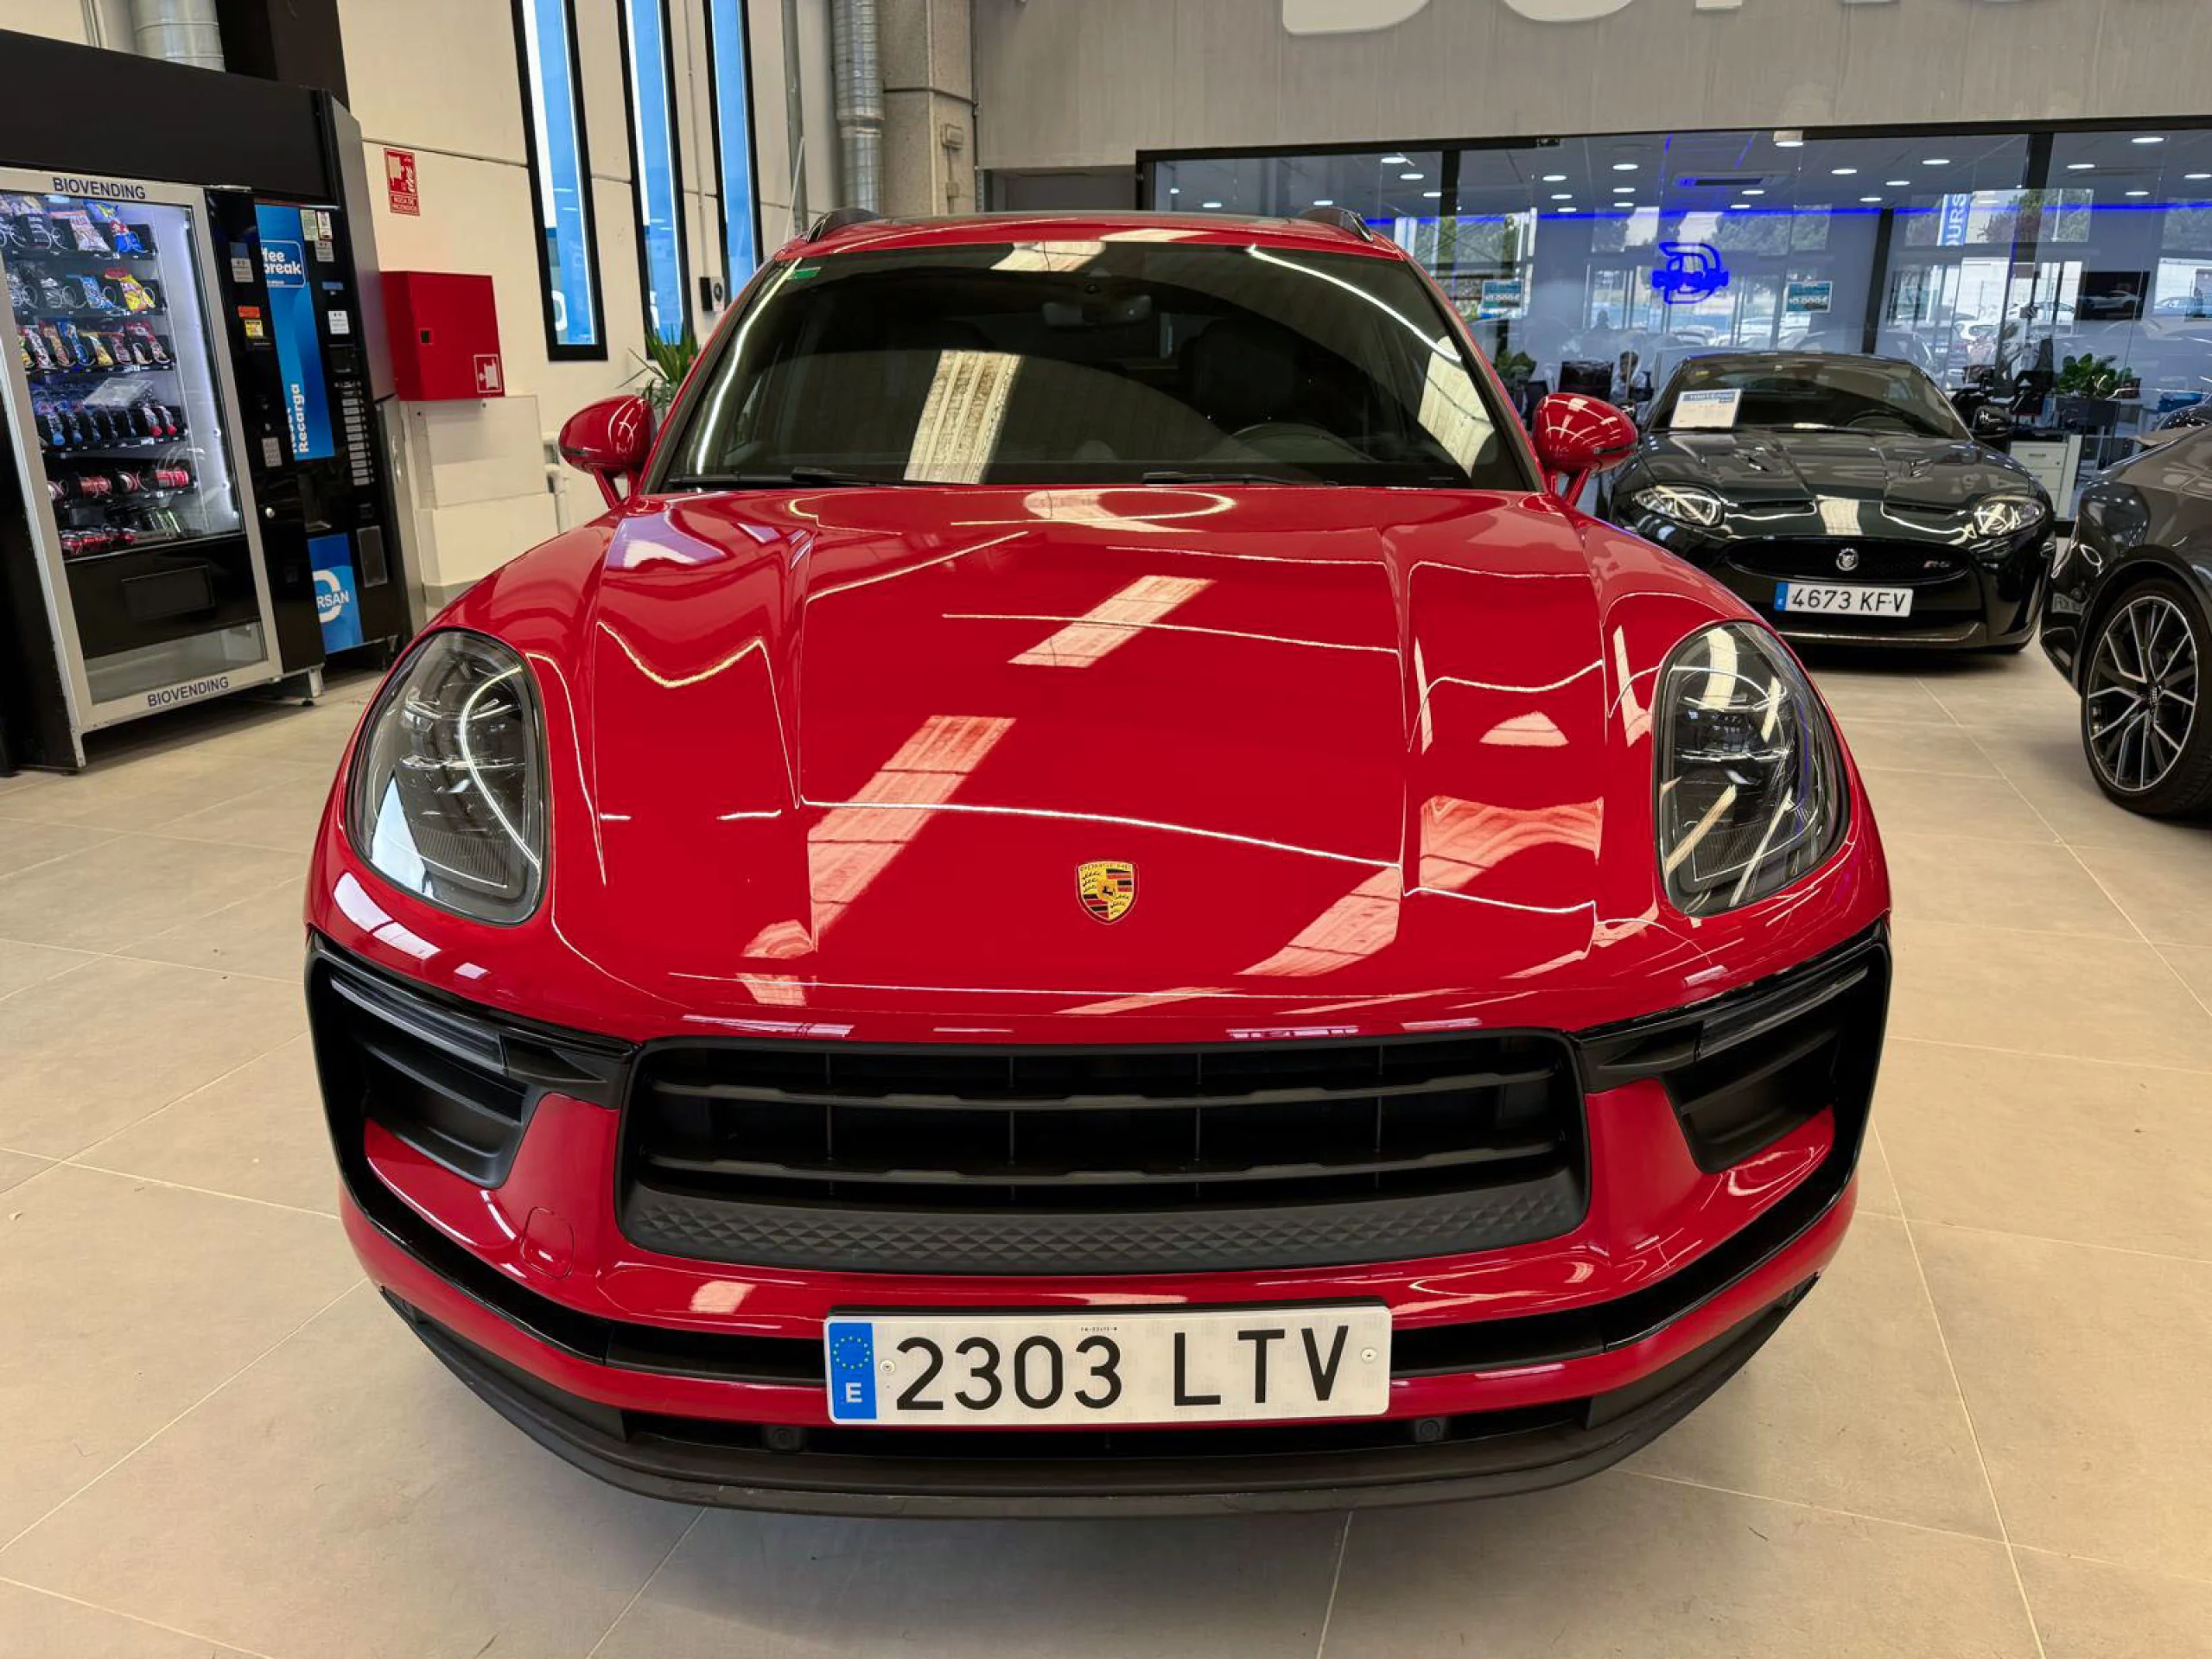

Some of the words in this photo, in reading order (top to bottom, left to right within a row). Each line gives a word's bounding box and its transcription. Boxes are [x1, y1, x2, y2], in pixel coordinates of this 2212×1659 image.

[53, 177, 146, 200] BIOVENDING
[290, 384, 309, 453] Recarga
[1792, 588, 1852, 610] 4673
[1859, 592, 1906, 613] KFV
[148, 677, 229, 707] BIOVENDING
[846, 1382, 862, 1402] E
[896, 1336, 1122, 1411] 2303
[1173, 1325, 1350, 1407] LTV
